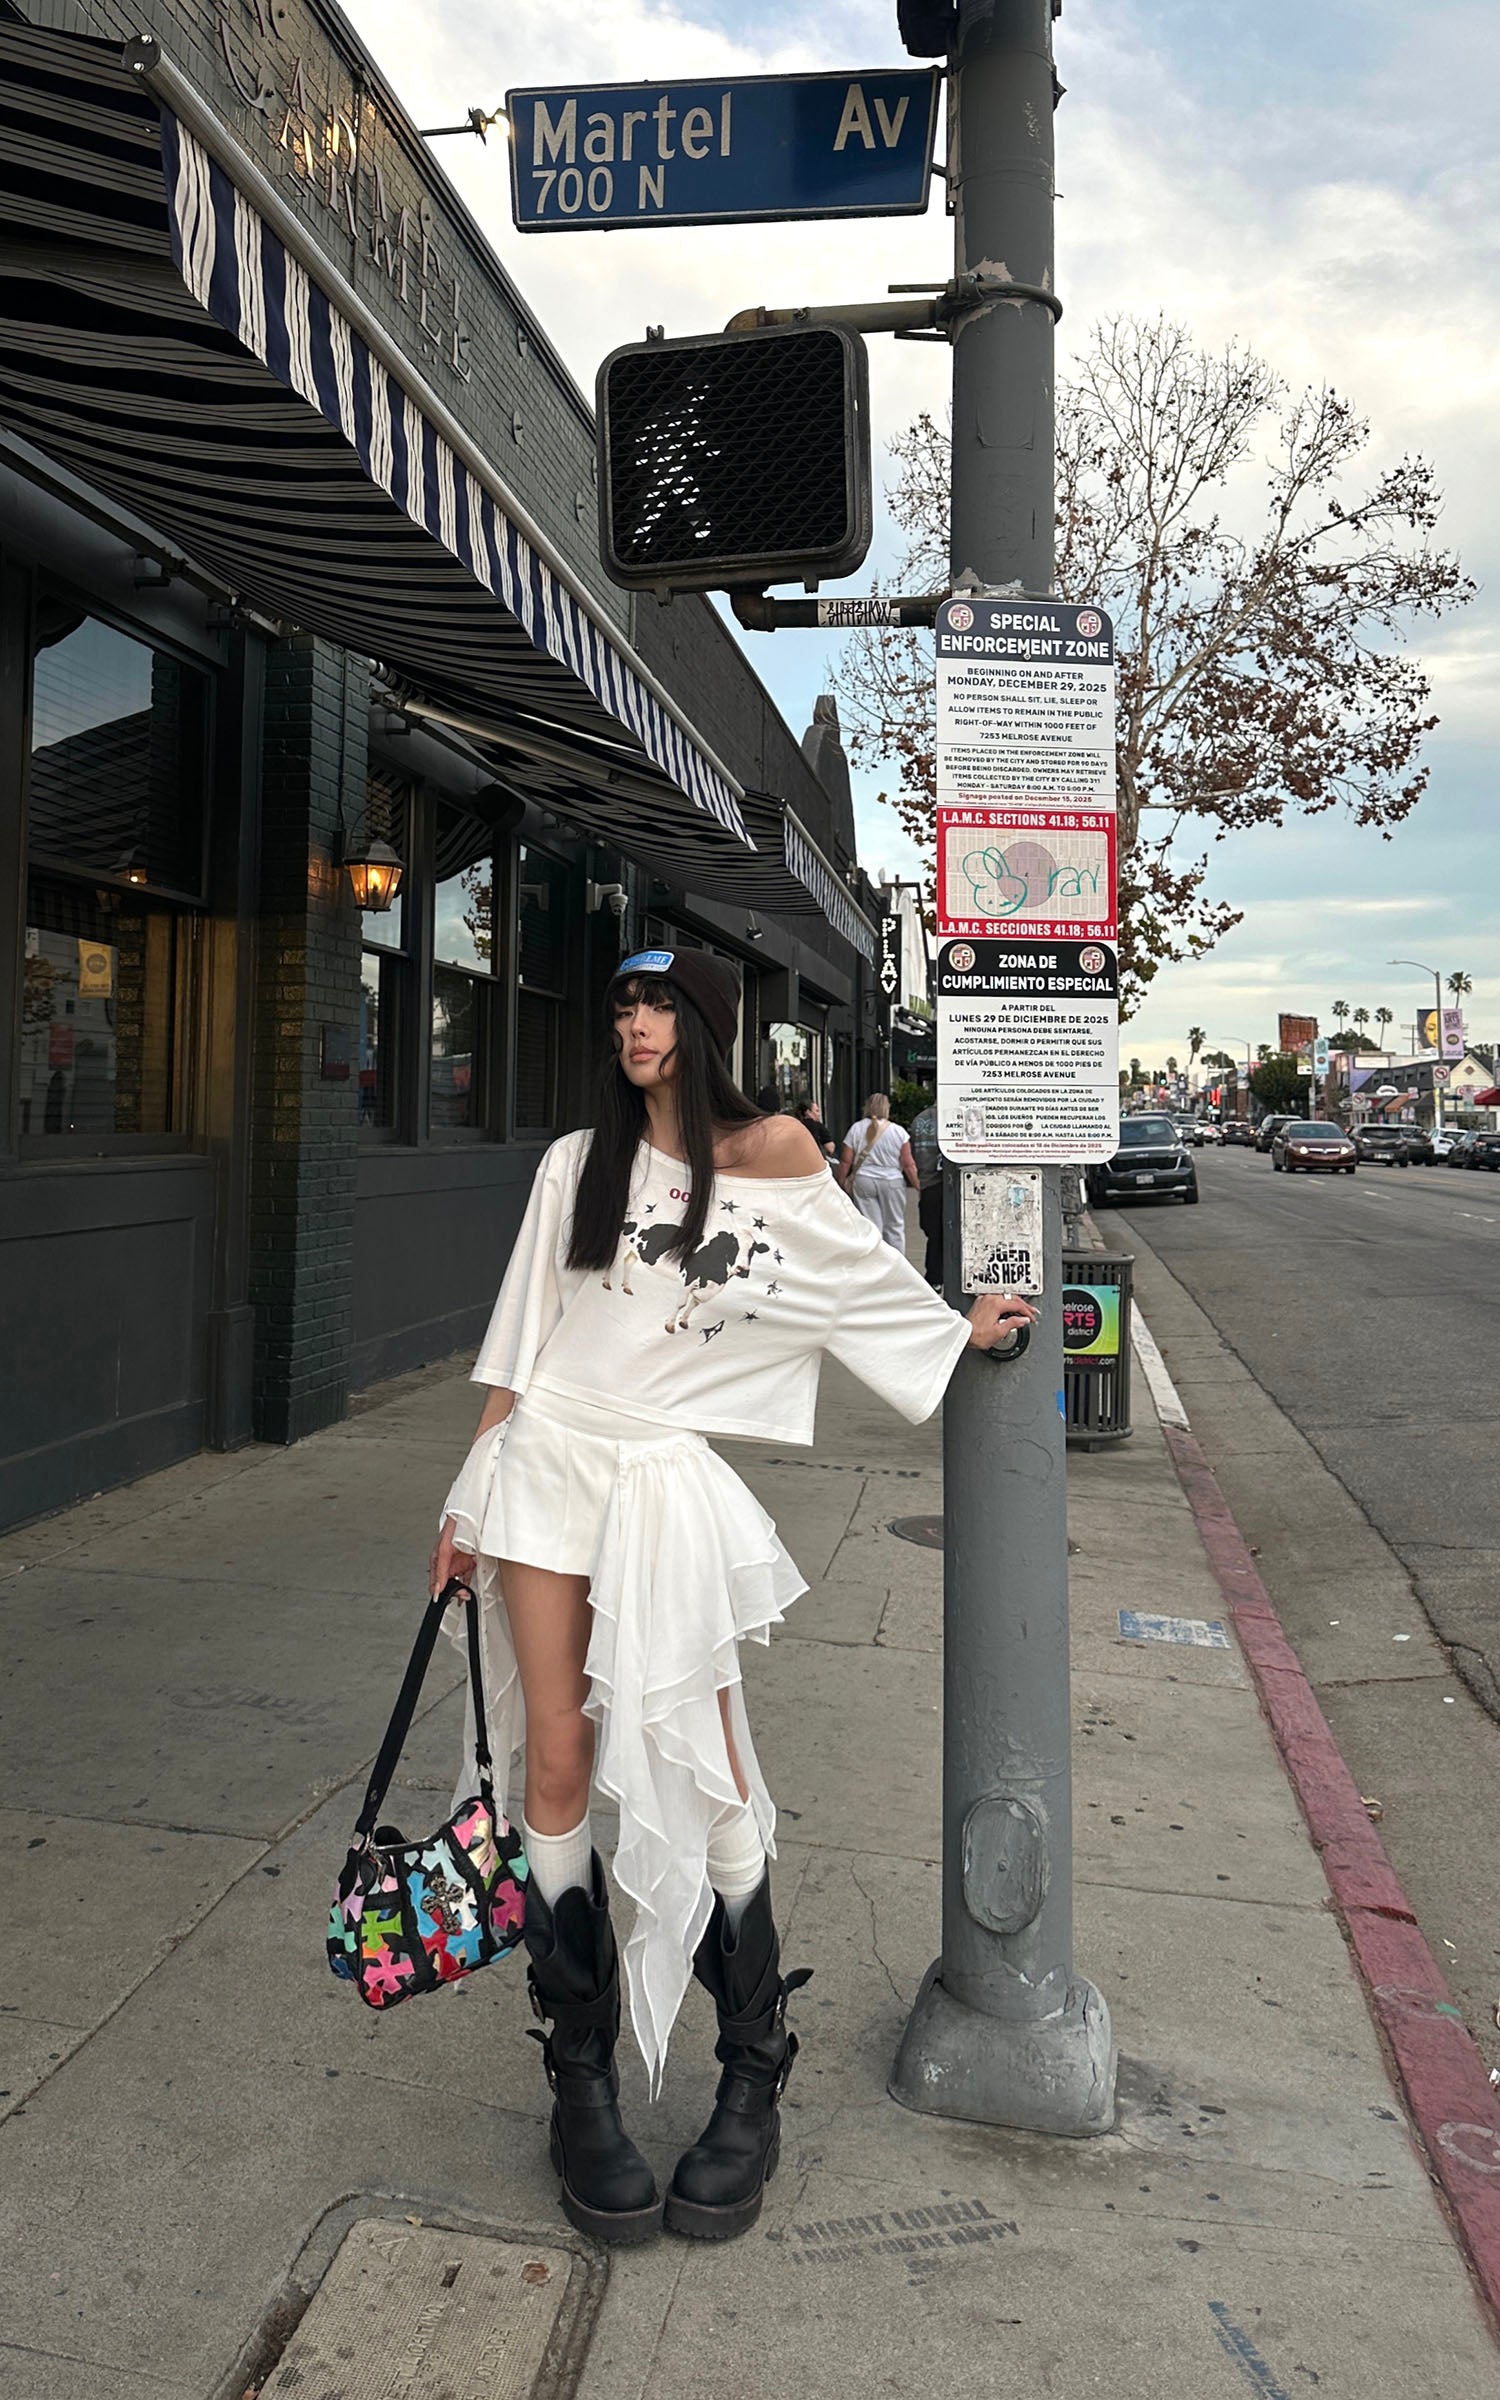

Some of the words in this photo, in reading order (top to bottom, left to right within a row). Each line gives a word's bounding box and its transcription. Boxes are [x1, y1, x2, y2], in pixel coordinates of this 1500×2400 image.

[532, 91, 731, 166] Martel
[832, 83, 910, 151] Av
[531, 166, 614, 215] 700
[638, 165, 665, 210] N
[990, 613, 1061, 632] SPECIAL
[941, 635, 1063, 656] ENFORCEMENT
[1065, 640, 1109, 658] ZONE
[968, 668, 1017, 677] BEGINNING
[1034, 670, 1053, 678] AND
[1055, 671, 1084, 680] AFTER
[948, 676, 996, 688] MONDAY,
[998, 679, 1058, 690] DECEMBER
[1060, 682, 1076, 692] 29,
[1079, 682, 1106, 692] 2025
[1015, 708, 1046, 716] REMAIN
[955, 719, 1012, 727] RIGHT-OF-WAY
[980, 732, 1000, 740] 7253
[1001, 733, 1039, 741] MELROSE
[1041, 734, 1072, 742] AVENUE
[942, 812, 985, 825] L.A.M.C.
[989, 813, 1046, 826] SECTIONS
[1049, 815, 1079, 828] 41.18;
[1082, 816, 1109, 828] 56.11
[939, 921, 982, 934] L.A.M.C.
[986, 922, 1050, 935] SECCIONES
[1054, 924, 1084, 937] 41.18;
[1087, 925, 1115, 937] 56.11
[999, 954, 1037, 969] ZONA
[1039, 956, 1057, 969] DE
[942, 975, 1045, 990] CUMPLIMIENTO
[1048, 977, 1114, 991] ESPECIAL
[949, 1014, 981, 1022] LUNES
[984, 1015, 996, 1023] 29
[998, 1015, 1011, 1023] DE
[1013, 1015, 1066, 1023] DICIEMBRE
[1084, 1016, 1108, 1024] 2025
[952, 1047, 993, 1055] ARTÍCULOS
[1002, 1263, 1031, 1284] HERE
[1063, 1302, 1094, 1312] elrose
[1063, 1312, 1096, 1327] RTS
[1067, 1328, 1094, 1336] district
[890, 2199, 1000, 2231] LOVELL
